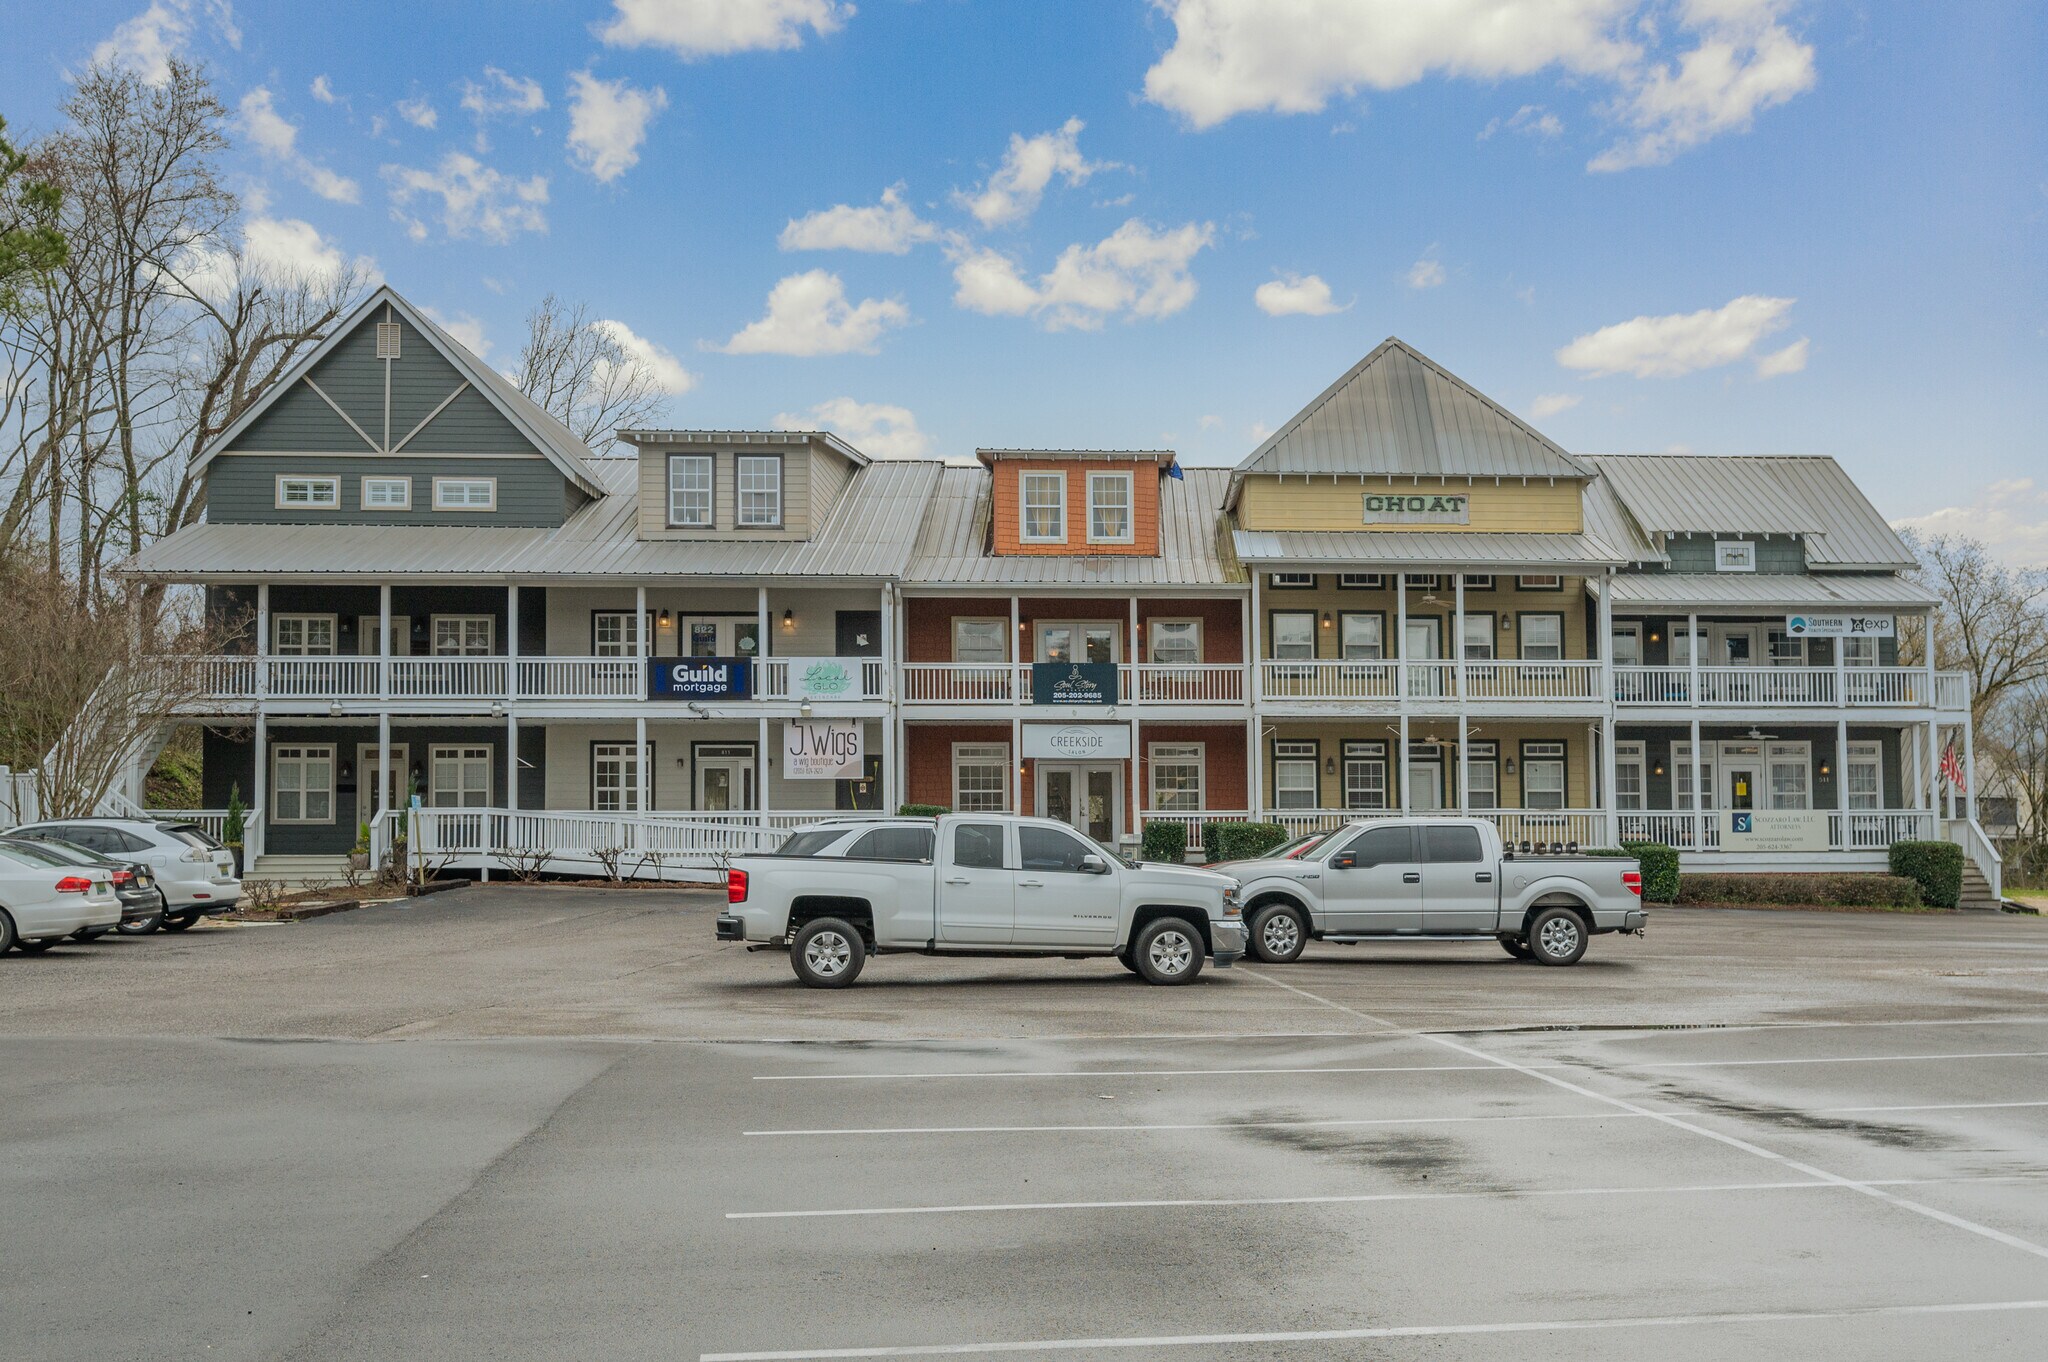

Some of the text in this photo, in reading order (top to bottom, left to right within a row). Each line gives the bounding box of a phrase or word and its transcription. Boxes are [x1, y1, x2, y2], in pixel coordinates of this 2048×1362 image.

[1366, 496, 1466, 512] CHOAT
[1808, 616, 1843, 627] SOUTHERN
[1865, 619, 1889, 631] exp
[692, 634, 716, 643] Guild
[672, 664, 727, 682] Guild
[799, 666, 853, 681] Local
[673, 682, 727, 693] mortgage
[813, 682, 838, 691] GLO
[1053, 680, 1097, 691] Soul Story
[1051, 736, 1103, 747] CREEKSIDE
[793, 756, 834, 768] a wig boutique
[1737, 816, 1747, 832] S
[1754, 815, 1787, 823] SCOZZARO
